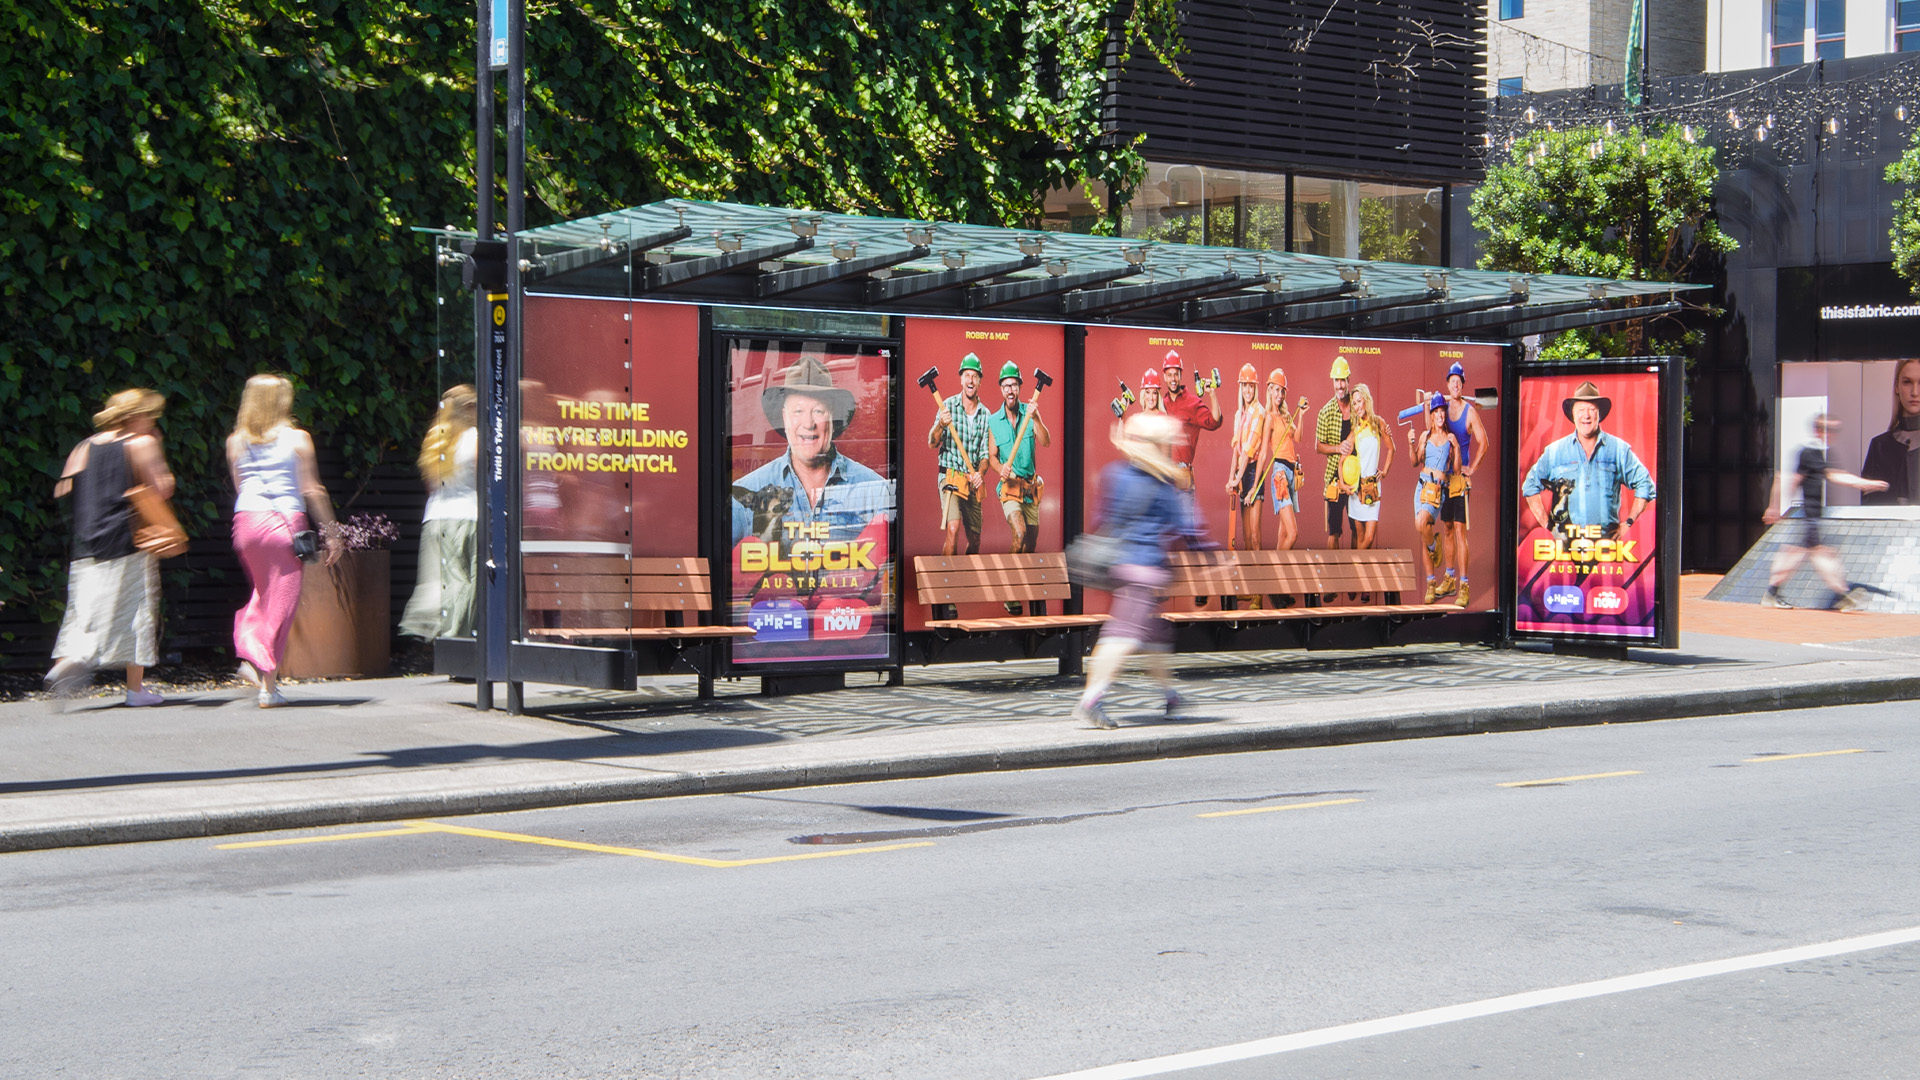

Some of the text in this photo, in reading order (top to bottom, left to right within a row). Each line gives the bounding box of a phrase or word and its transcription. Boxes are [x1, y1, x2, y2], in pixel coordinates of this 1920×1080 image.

[1821, 304, 1920, 319] thisisfabric.com
[965, 331, 1010, 341] ROBBY & MAT
[1149, 337, 1184, 347] BRITT & TAZ
[1251, 342, 1265, 350] HAN
[1269, 343, 1283, 351] CAN
[1339, 346, 1358, 354] SONNY
[1363, 347, 1381, 355] ALICIA
[1452, 351, 1464, 359] BEN
[495, 348, 503, 381] Street
[494, 383, 504, 410] Tyler
[557, 400, 650, 421] THIS TIME
[494, 416, 503, 444] Tyler
[600, 428, 688, 448] BUILDING
[495, 445, 502, 455] o
[526, 452, 678, 473] FROM SCRATCH.
[783, 521, 830, 539] THE
[1565, 524, 1602, 538] THE
[741, 541, 878, 572] BLOCK
[1533, 539, 1639, 562] BLOCK
[1549, 565, 1623, 575] AUSTRALIA
[762, 577, 858, 588] AUSTRALIA
